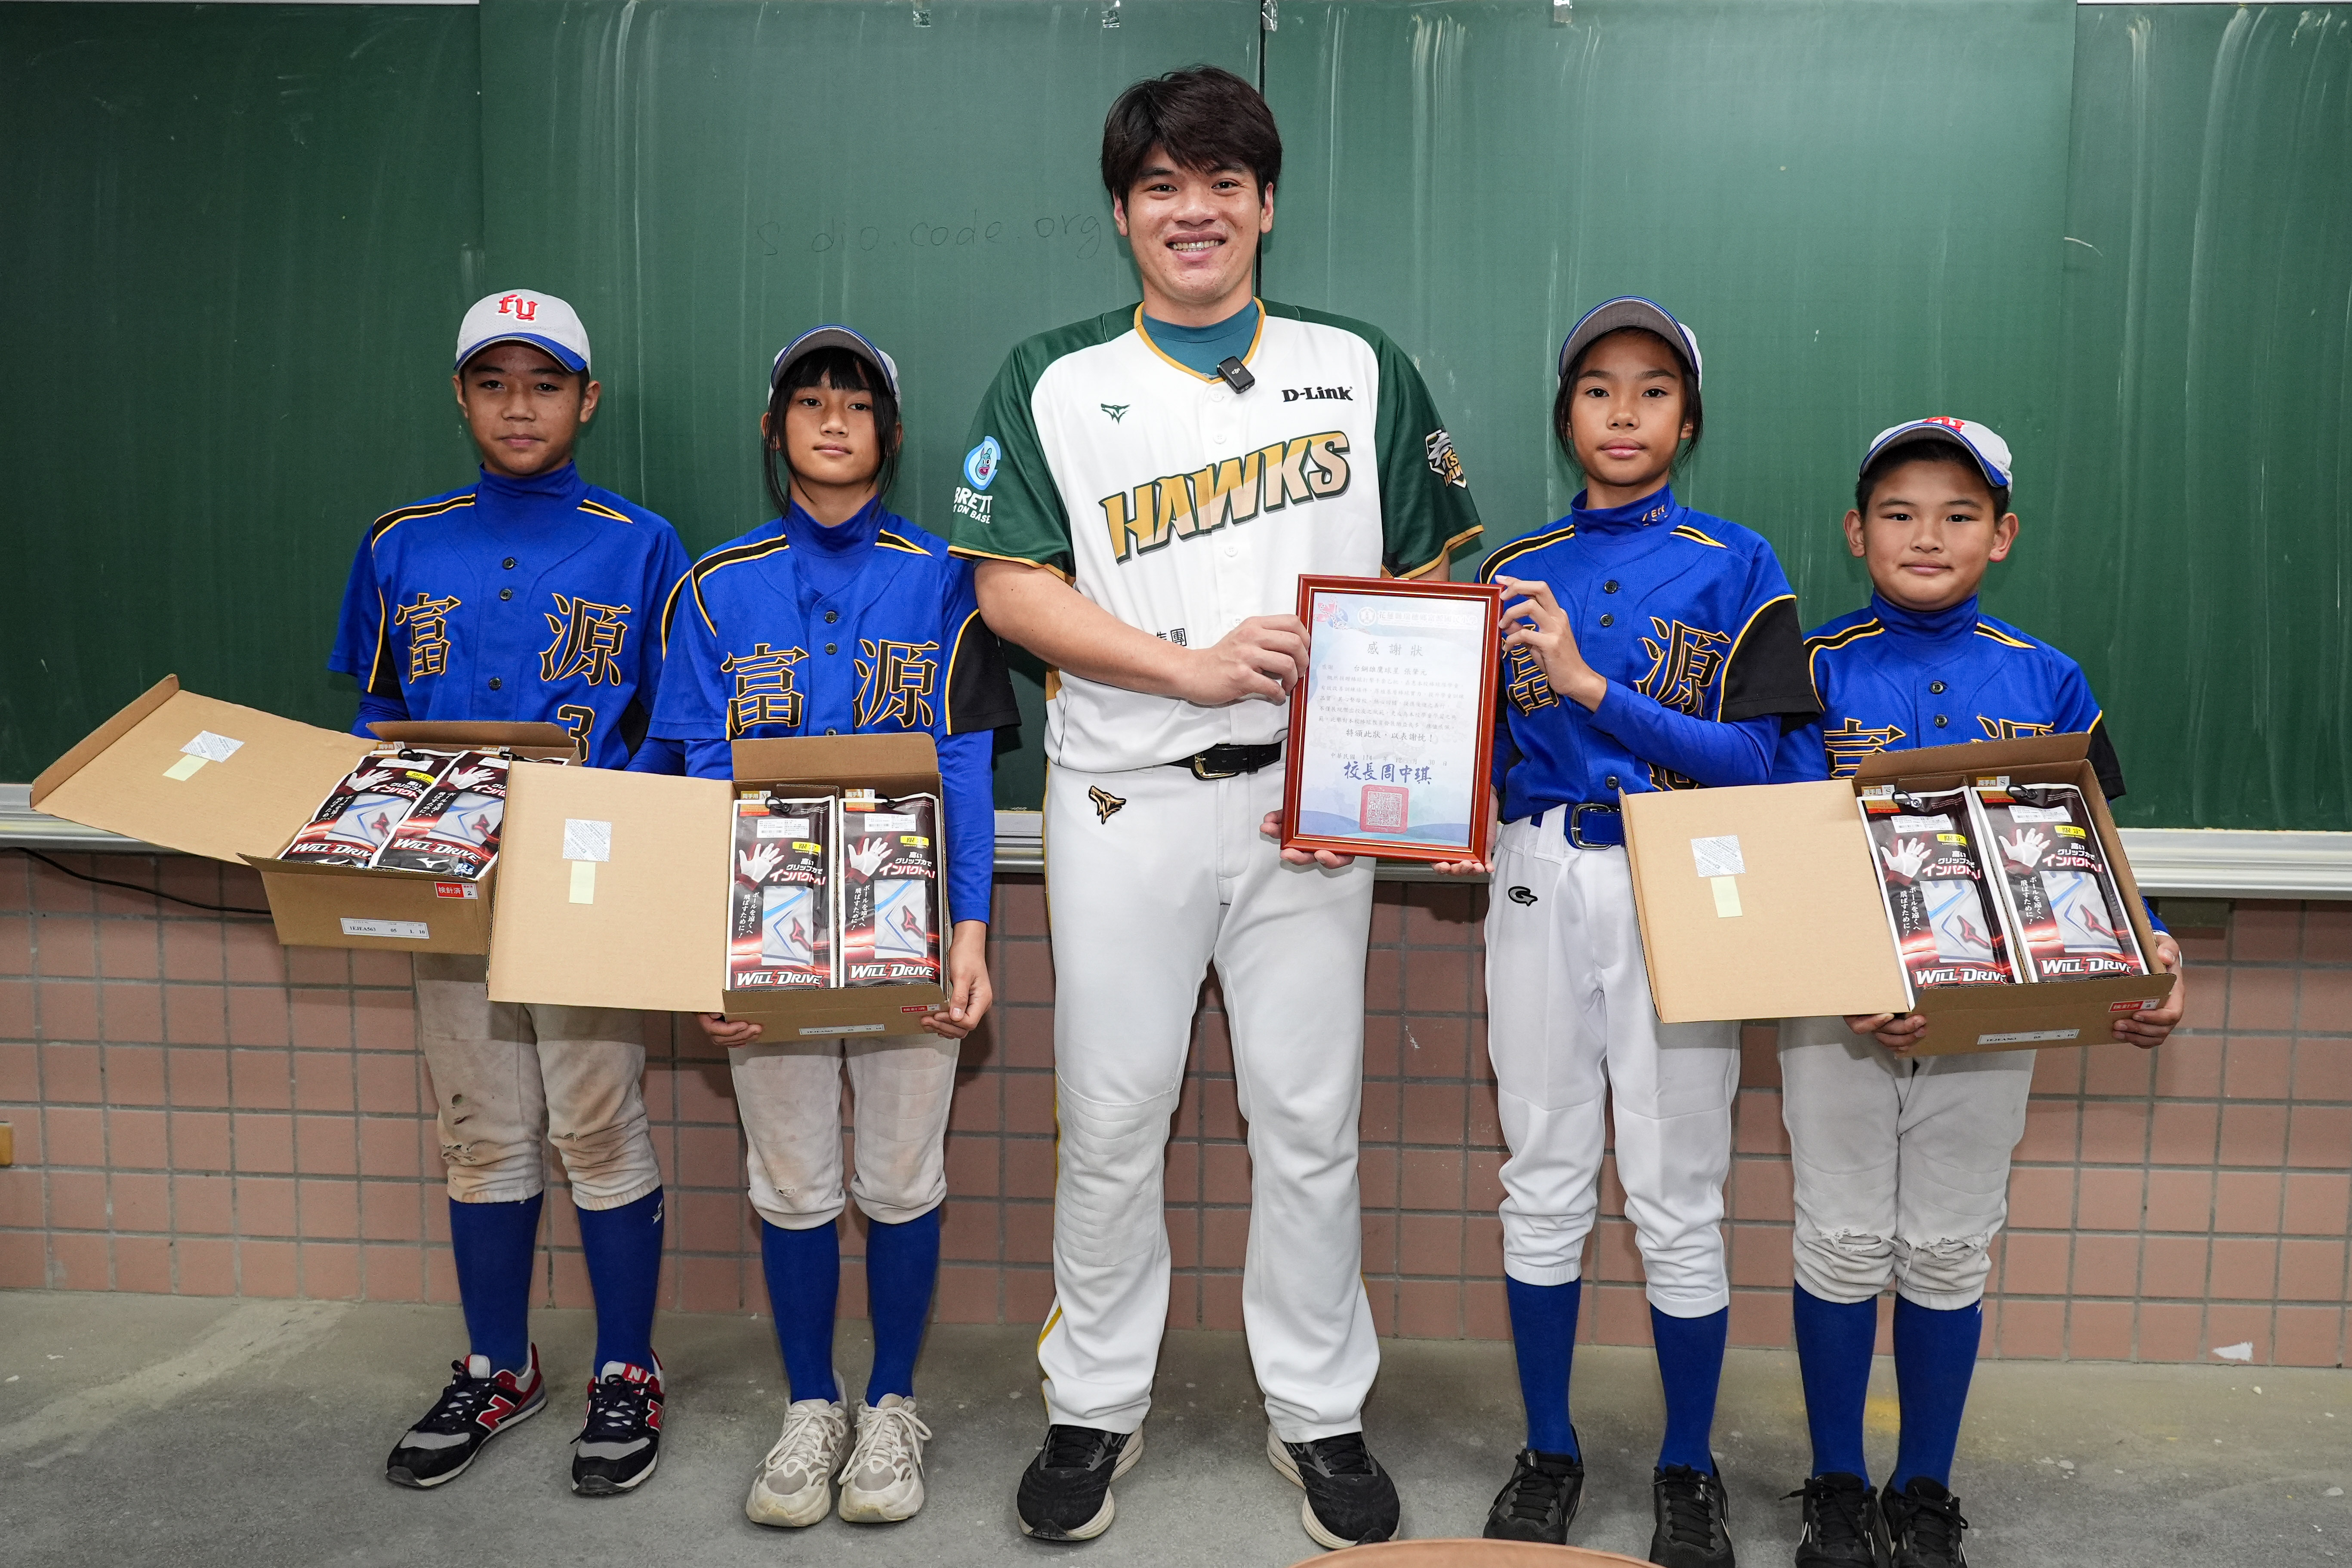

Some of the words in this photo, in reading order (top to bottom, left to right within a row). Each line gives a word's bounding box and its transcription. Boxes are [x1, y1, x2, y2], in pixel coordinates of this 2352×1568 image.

[1282, 386, 1353, 402] D-Link
[1098, 431, 1351, 565] HAWKS
[957, 505, 970, 514] ON
[969, 510, 991, 524] BASE
[1368, 641, 1424, 656] 感謝狀
[558, 704, 595, 762] 3
[1344, 761, 1432, 785] 校長周中琪
[293, 843, 331, 853] WILL
[331, 844, 373, 859] DRIV
[395, 838, 432, 851] WILL
[432, 844, 482, 862] DRIVE
[2071, 842, 2085, 850] 高い
[800, 858, 814, 866] 高い
[858, 884, 870, 927] ボールを遠くへ
[2029, 876, 2044, 920] ボールを遠くへ
[746, 891, 760, 935] ボールを遠くへ
[1909, 887, 1921, 931] ボールを遠くへ
[850, 964, 886, 979] WILL
[886, 964, 933, 977] DRIVE
[2041, 959, 2085, 975] WILL
[736, 971, 774, 987] WILL
[776, 971, 823, 986] DRIVE
[1915, 968, 1958, 986] WILL
